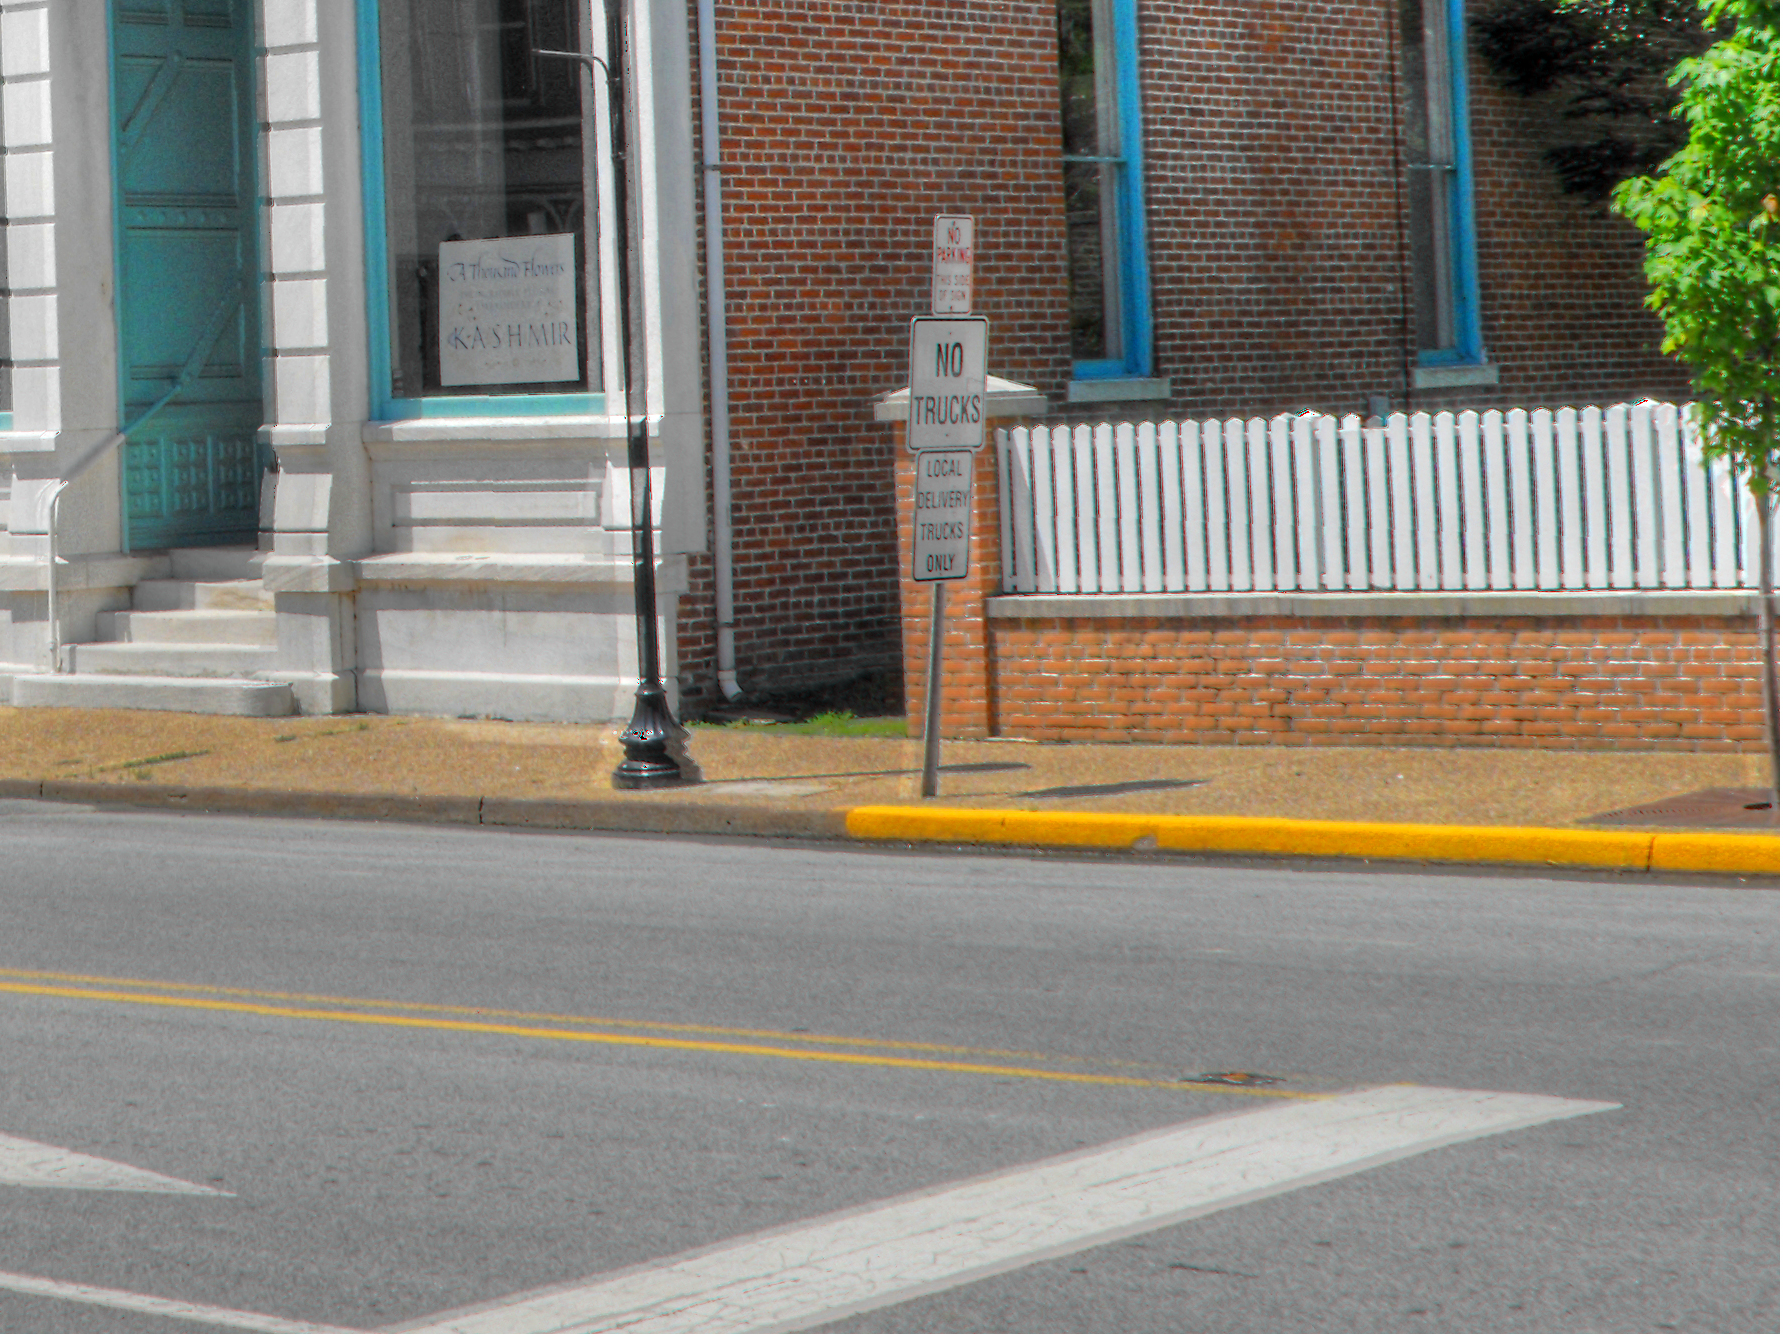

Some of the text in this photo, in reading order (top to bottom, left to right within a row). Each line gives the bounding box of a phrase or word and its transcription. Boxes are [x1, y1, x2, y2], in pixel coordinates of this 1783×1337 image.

[947, 227, 961, 244] NO
[937, 247, 970, 264] PARKING
[447, 262, 466, 281] A
[953, 274, 970, 286] SIDE
[950, 289, 966, 301] SIGN
[451, 321, 572, 350] KASHMIR
[936, 342, 964, 377] NO
[915, 394, 980, 425] TRUCKS
[926, 459, 963, 477] LOCAL
[917, 490, 969, 509] DELIVERY
[920, 521, 964, 541] TRUCKS
[926, 553, 955, 572] ONLY
